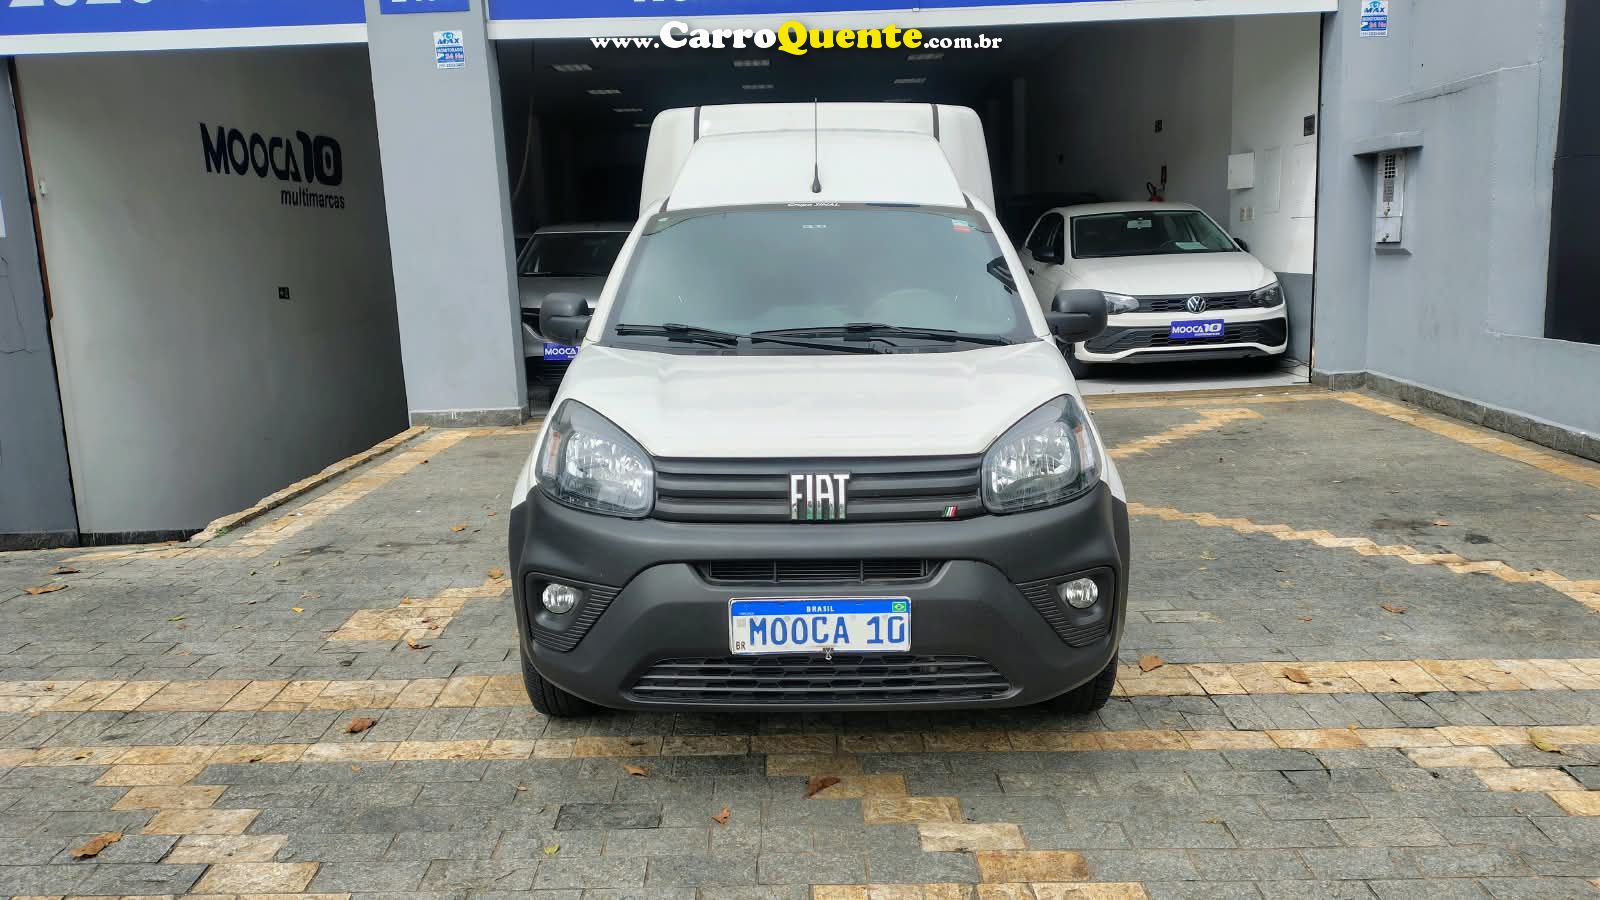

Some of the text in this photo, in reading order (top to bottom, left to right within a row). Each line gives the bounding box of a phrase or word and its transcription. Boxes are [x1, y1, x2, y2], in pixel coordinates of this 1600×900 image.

[280, 187, 345, 209] multimarcas
[790, 474, 850, 519] FIAT
[750, 615, 905, 646] MOOCA 10
[735, 641, 746, 650] BR
